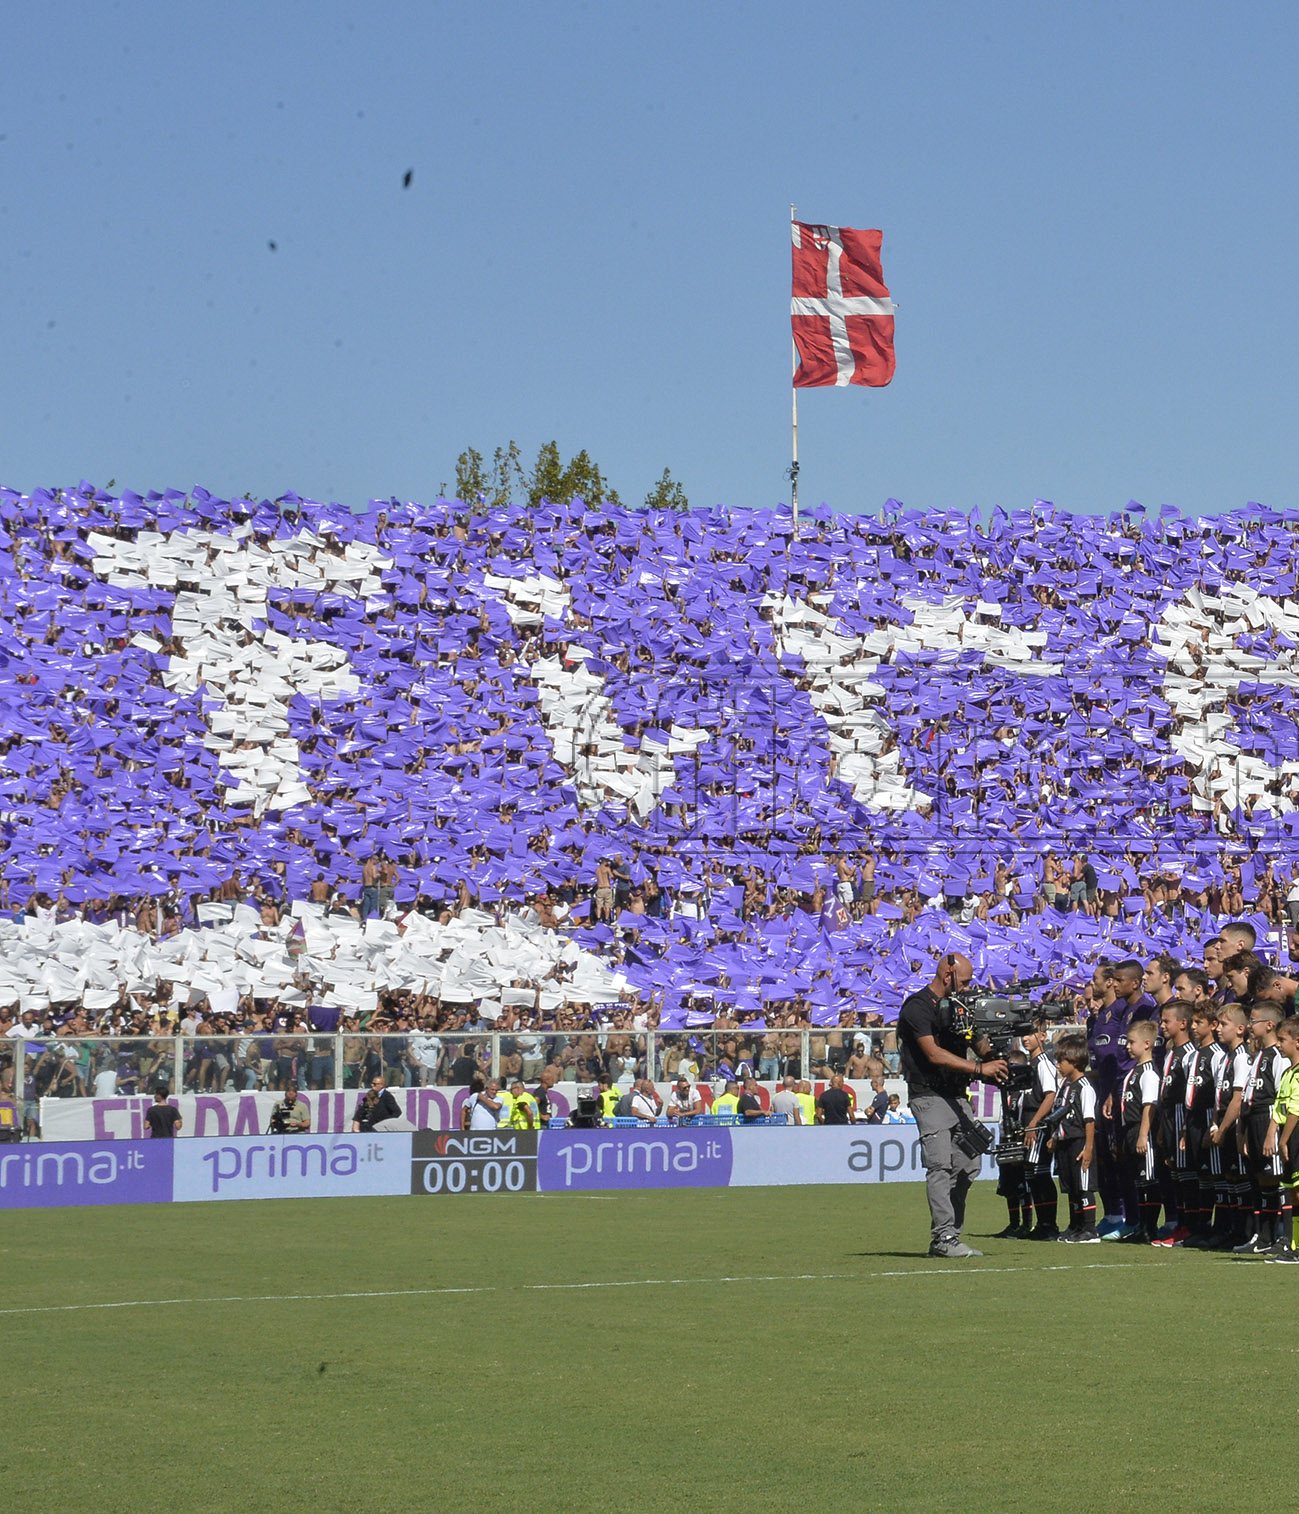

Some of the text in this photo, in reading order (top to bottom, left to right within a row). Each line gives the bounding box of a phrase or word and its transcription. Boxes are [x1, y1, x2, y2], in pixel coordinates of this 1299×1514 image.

[445, 1136, 516, 1156] NGM
[557, 1139, 722, 1186] prima.it
[847, 1138, 922, 1182] apr
[0, 1150, 145, 1188] rima.it
[203, 1143, 384, 1193] prima.it
[423, 1160, 525, 1194] 00:00
